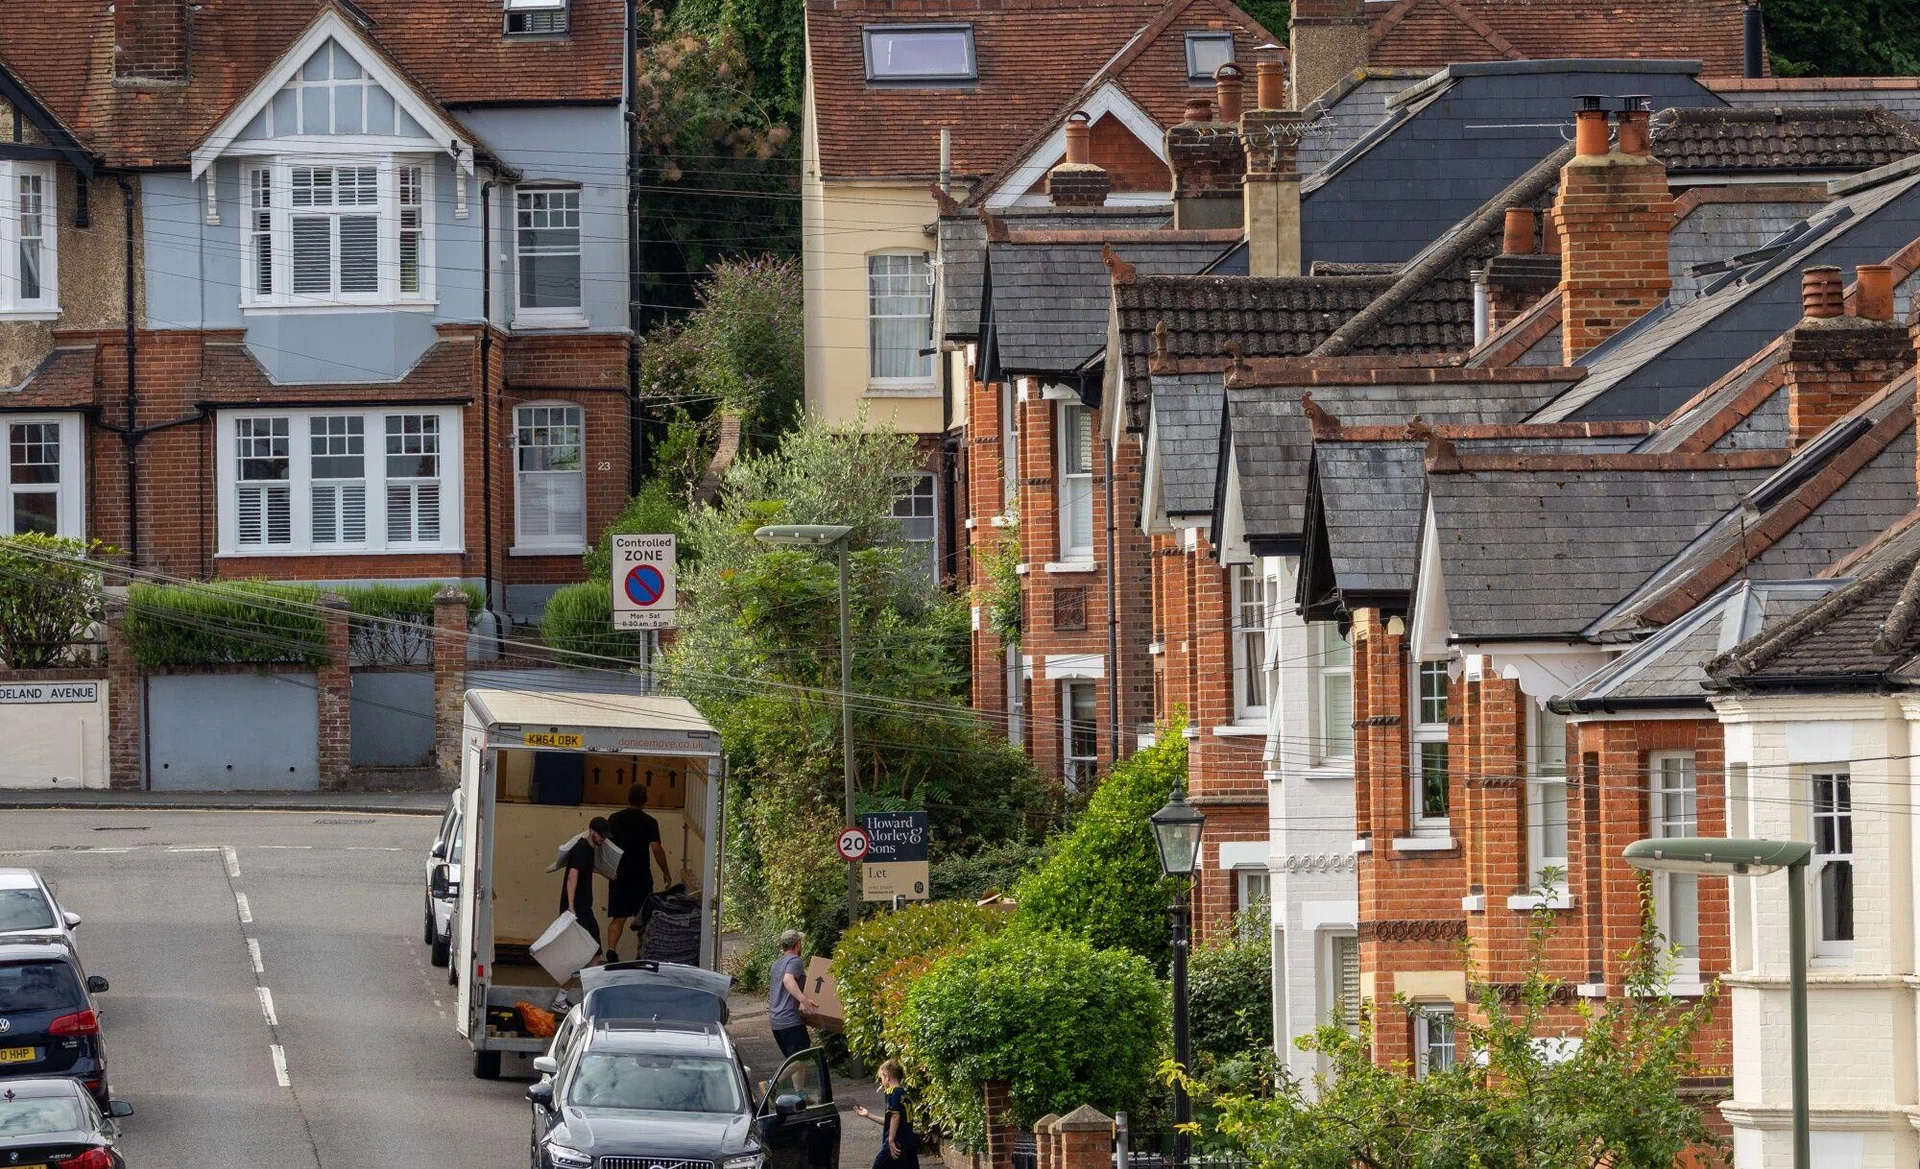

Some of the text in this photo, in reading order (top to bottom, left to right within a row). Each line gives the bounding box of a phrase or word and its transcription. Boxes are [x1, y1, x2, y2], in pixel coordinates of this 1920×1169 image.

[597, 461, 611, 471] 23
[616, 538, 671, 548] Controlled
[624, 550, 663, 561] ZONE
[0, 687, 94, 699] DELAND AVENUE
[867, 816, 913, 829] Howard
[842, 837, 865, 850] 20
[868, 842, 896, 854] Sons
[869, 867, 887, 878] Let
[10, 1049, 29, 1060] HHP
